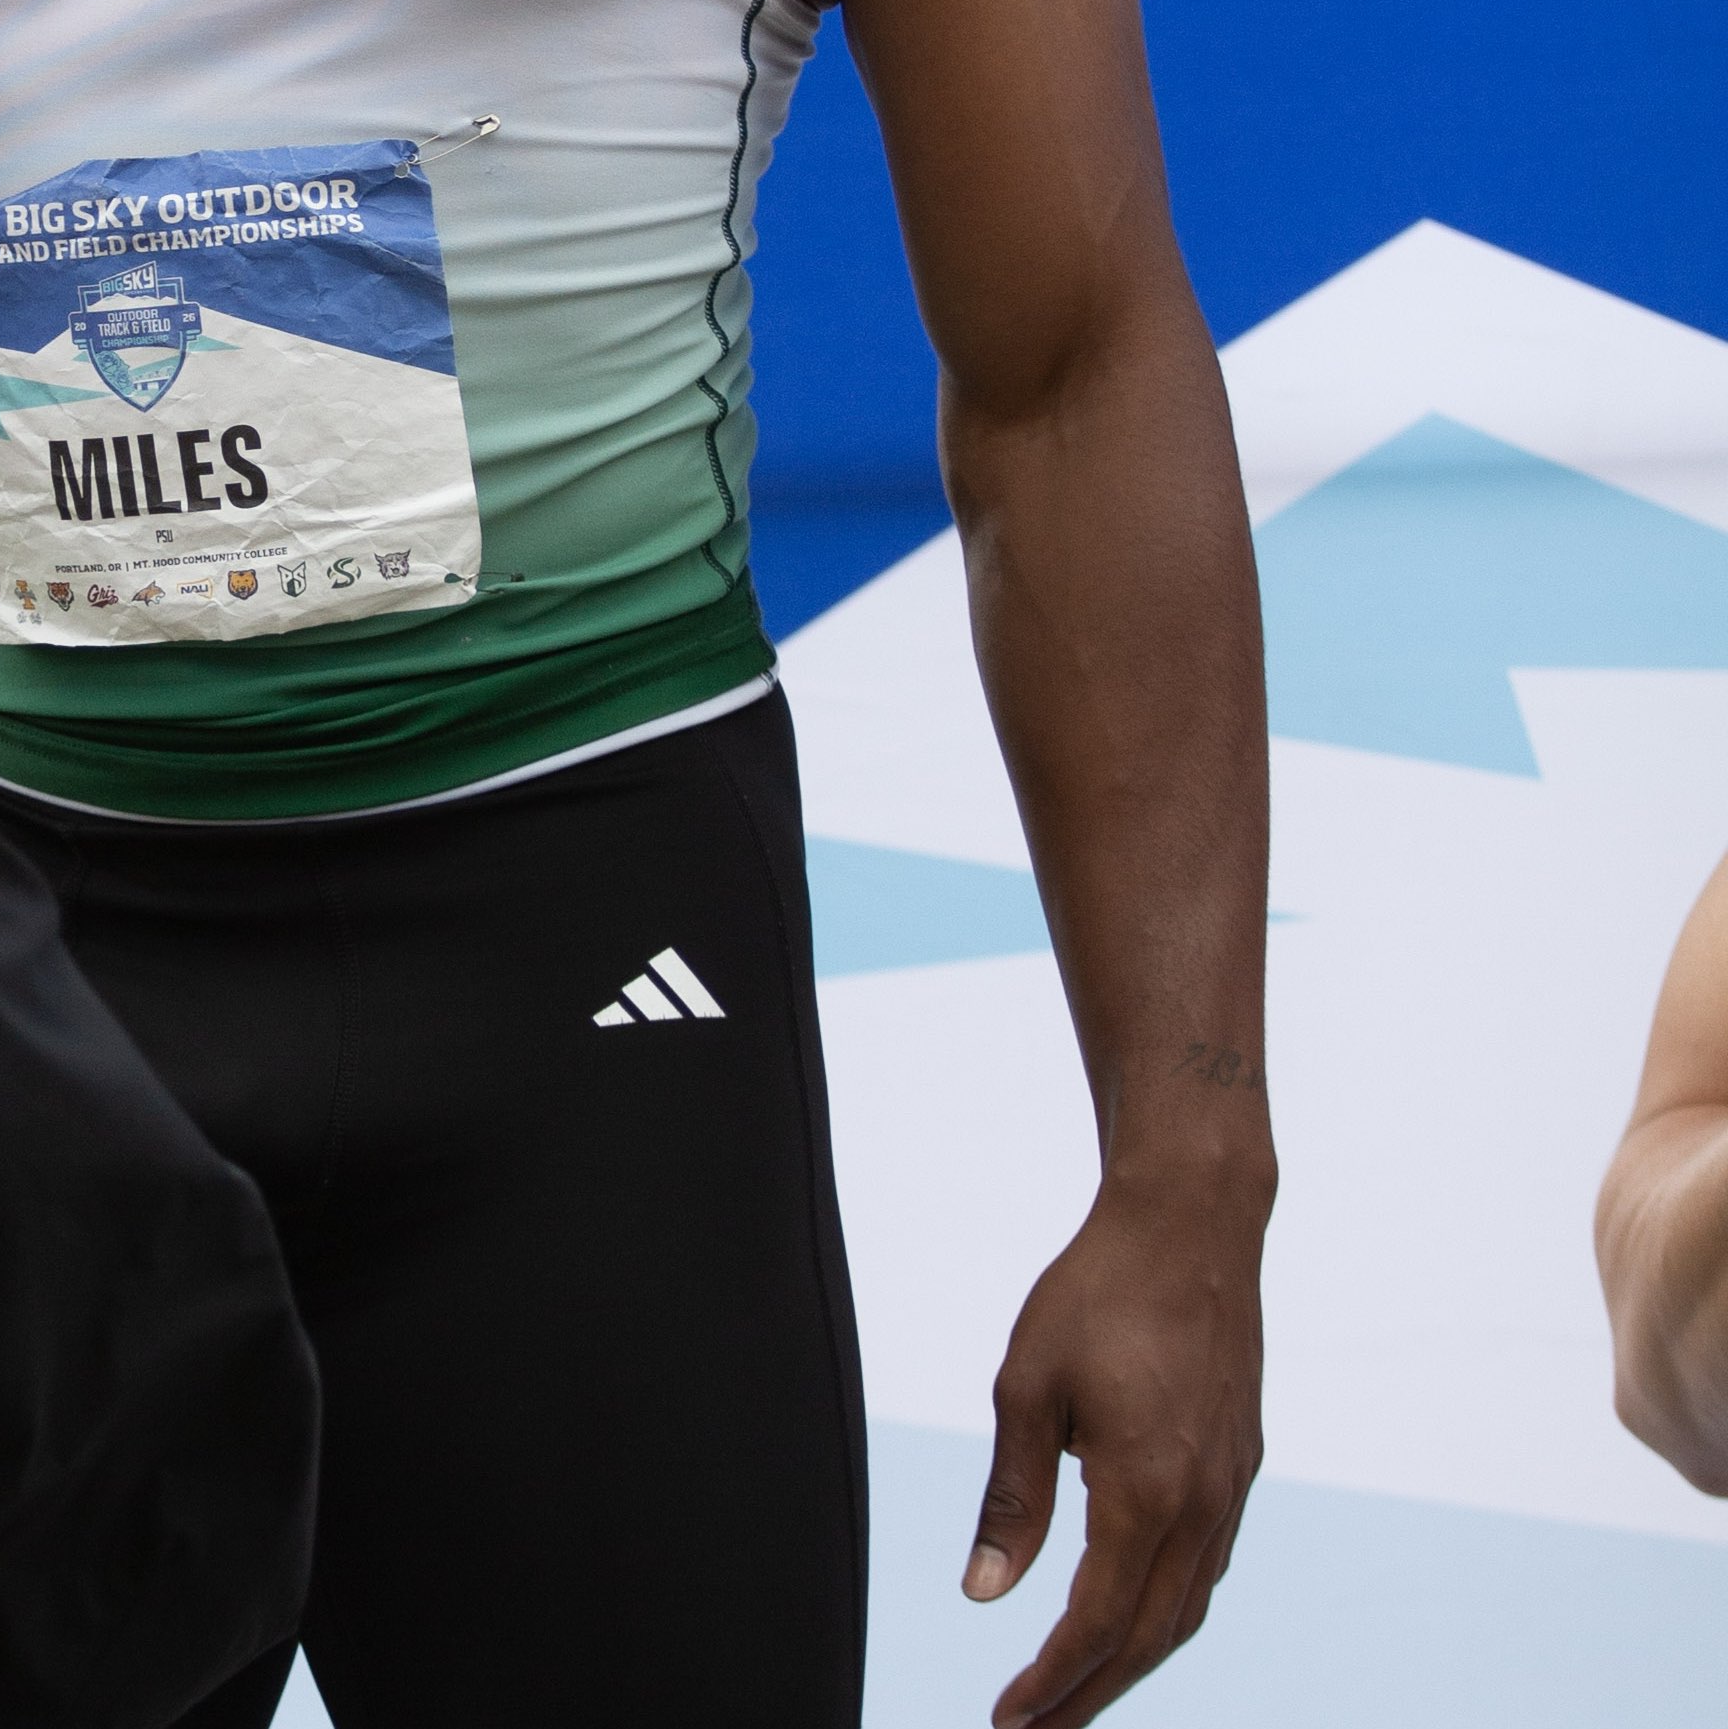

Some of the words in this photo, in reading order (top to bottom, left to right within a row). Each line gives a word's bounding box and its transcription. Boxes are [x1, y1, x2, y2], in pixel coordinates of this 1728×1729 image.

[5, 202, 66, 237] BIG
[71, 194, 150, 233] SKY
[157, 178, 359, 225] OUTDOOR
[53, 234, 127, 261] FIELD
[132, 212, 365, 254] CHAMPIONSHIPS
[107, 308, 159, 322] OUTDOOR
[182, 313, 196, 323] 26
[74, 322, 87, 332] 20
[97, 322, 130, 337] TRACK
[132, 321, 140, 335] &
[141, 318, 172, 334] FIELD
[47, 423, 270, 522] MILES
[155, 529, 174, 544] PSU
[55, 563, 107, 574] PORTLAND,
[108, 562, 122, 572] OR
[133, 560, 152, 570] MT.
[153, 557, 181, 569] HOOD
[182, 551, 242, 565] COMMUNITY
[243, 546, 289, 560] COLLEGE
